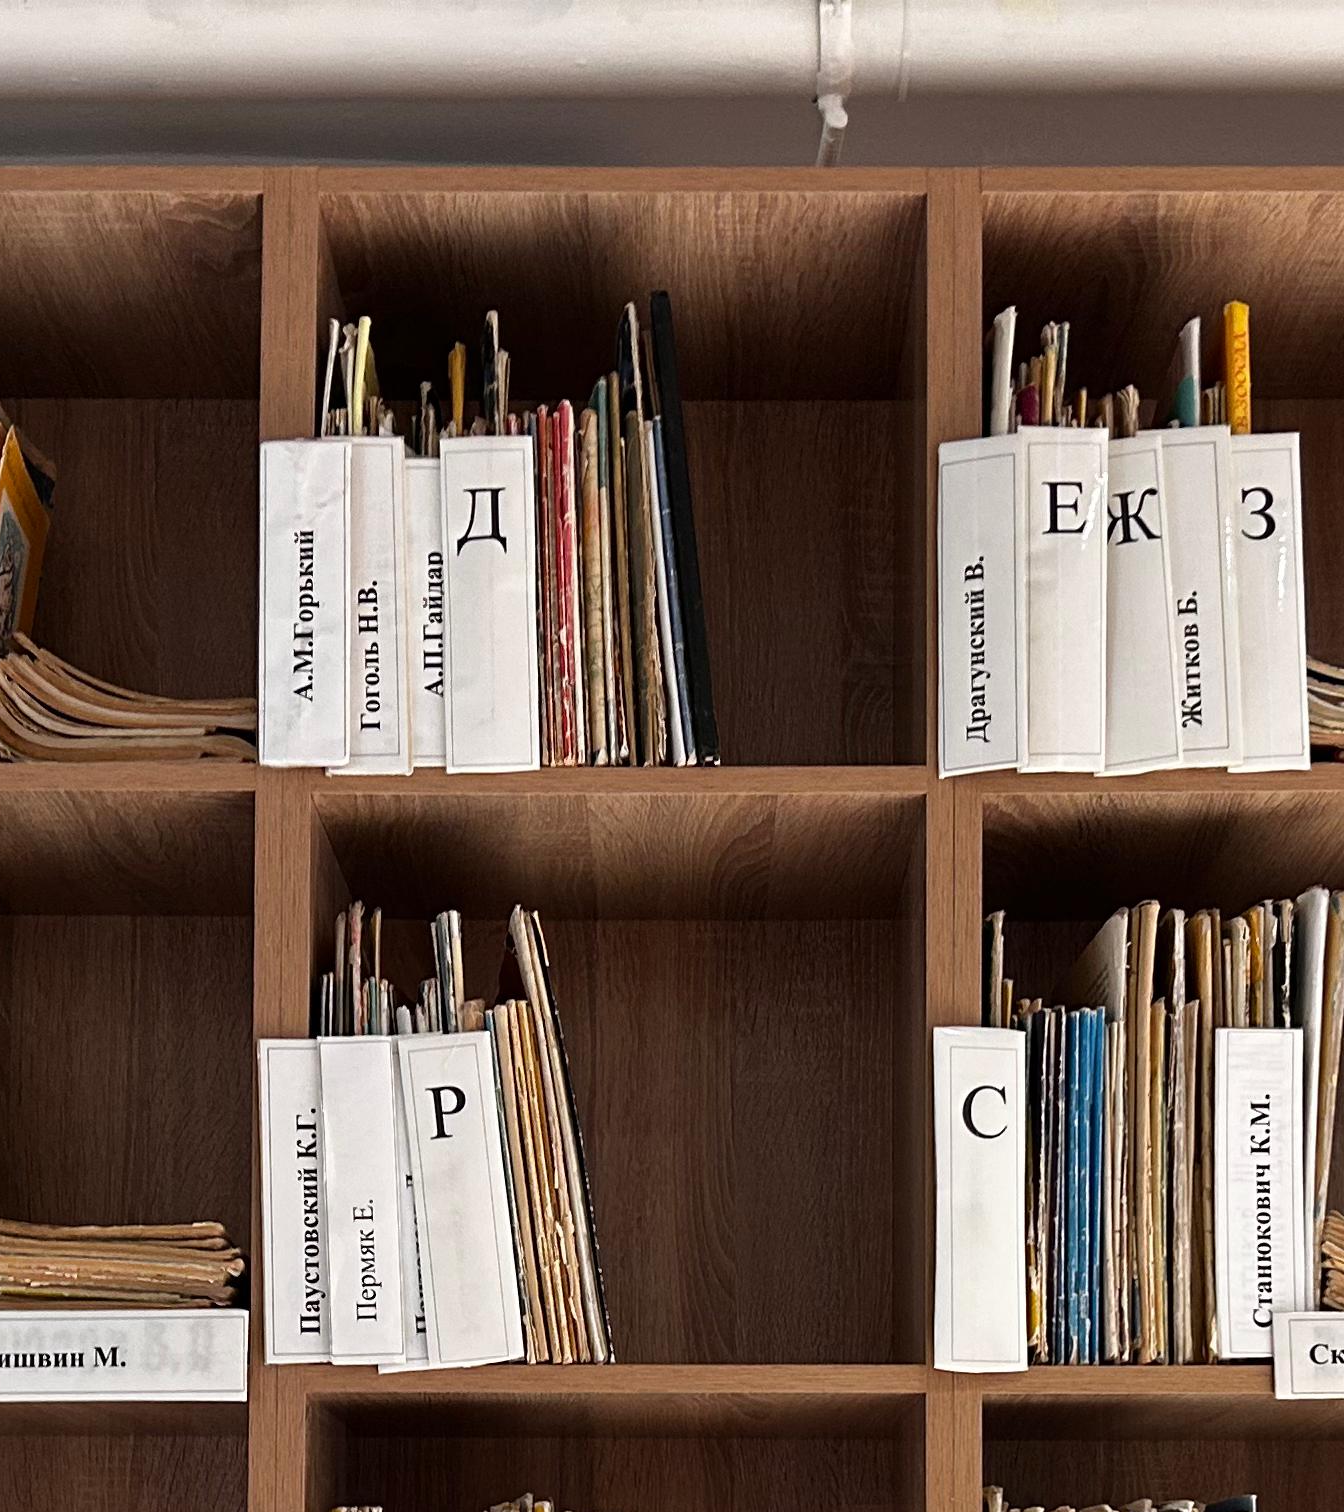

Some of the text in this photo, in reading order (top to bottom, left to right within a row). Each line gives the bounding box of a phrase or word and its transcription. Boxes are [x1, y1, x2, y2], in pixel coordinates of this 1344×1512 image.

[456, 487, 508, 556] Д
[1042, 481, 1086, 536] Е
[1107, 487, 1161, 545] Ж
[1240, 487, 1276, 540] З
[293, 530, 316, 703] А.М.Горький
[357, 579, 381, 732] Гоголь Н.В.
[423, 551, 444, 698] А.П.Гайдар
[965, 556, 992, 743] Драгунский В.
[1177, 590, 1203, 728] Житков Б.
[425, 1085, 467, 1139] Р
[962, 1085, 1008, 1139] С
[295, 1107, 328, 1336] Паустовский К.Г.
[352, 1198, 382, 1323] Пермяк Е.
[1250, 1093, 1274, 1329] Станюкович К.М.
[93, 1346, 127, 1369] М.
